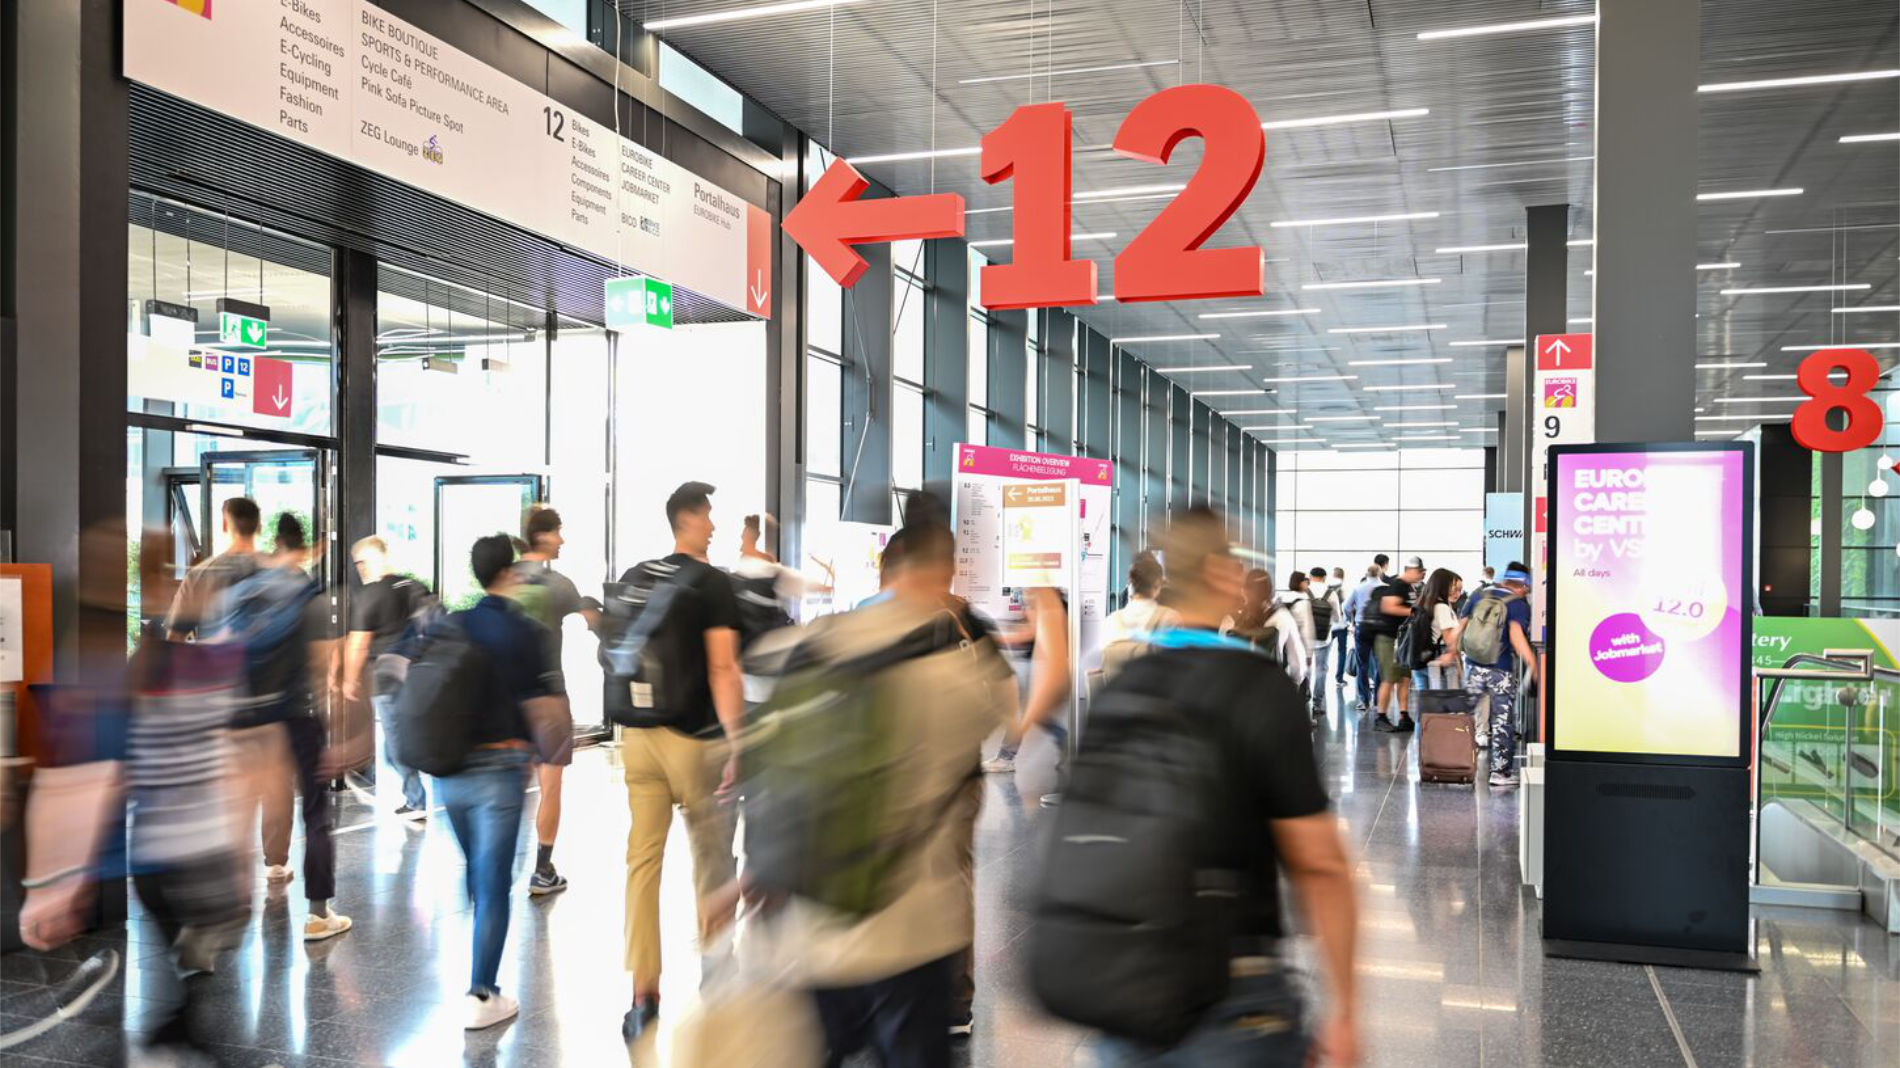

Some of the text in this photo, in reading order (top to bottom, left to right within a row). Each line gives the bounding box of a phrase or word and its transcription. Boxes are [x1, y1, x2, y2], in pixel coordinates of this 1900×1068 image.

[280, 16, 345, 57] Accessoires
[361, 10, 438, 60] BIKE BOUTIQUE
[281, 39, 331, 77] E-Cycling
[280, 62, 339, 100] Equipment
[361, 55, 412, 90] Cycle Café
[361, 32, 509, 115] SPORTS & PERFORMANCE AREA
[280, 86, 323, 116] Fashion
[361, 77, 464, 134] Pink Sofa Picture Spot
[280, 109, 308, 133] Parts
[543, 106, 565, 143] 12
[571, 119, 590, 138] Bikes
[360, 120, 381, 141] ZEG
[384, 130, 419, 157] Lounge
[571, 137, 596, 158] E-Bikes
[571, 155, 610, 182] Accessoires
[621, 145, 653, 170] EUROBIKE
[571, 173, 612, 201] Components
[621, 162, 671, 194] CAREER CENTER
[571, 190, 607, 215] Equipment
[621, 180, 659, 205] JOBMARKET
[694, 182, 741, 220] Portalhaus
[979, 84, 1266, 310] 12
[571, 208, 589, 225] Parts
[621, 212, 638, 229] BICO
[693, 204, 720, 226] EUROBIKE
[1791, 348, 1884, 453] 8
[1544, 415, 1560, 439] 9
[1574, 468, 1649, 489] EURO
[1488, 529, 1524, 539] SCHW
[1575, 539, 1603, 562] by
[1573, 568, 1611, 579] All days
[1593, 642, 1664, 661] Jobmarket
[1610, 632, 1640, 646] with
